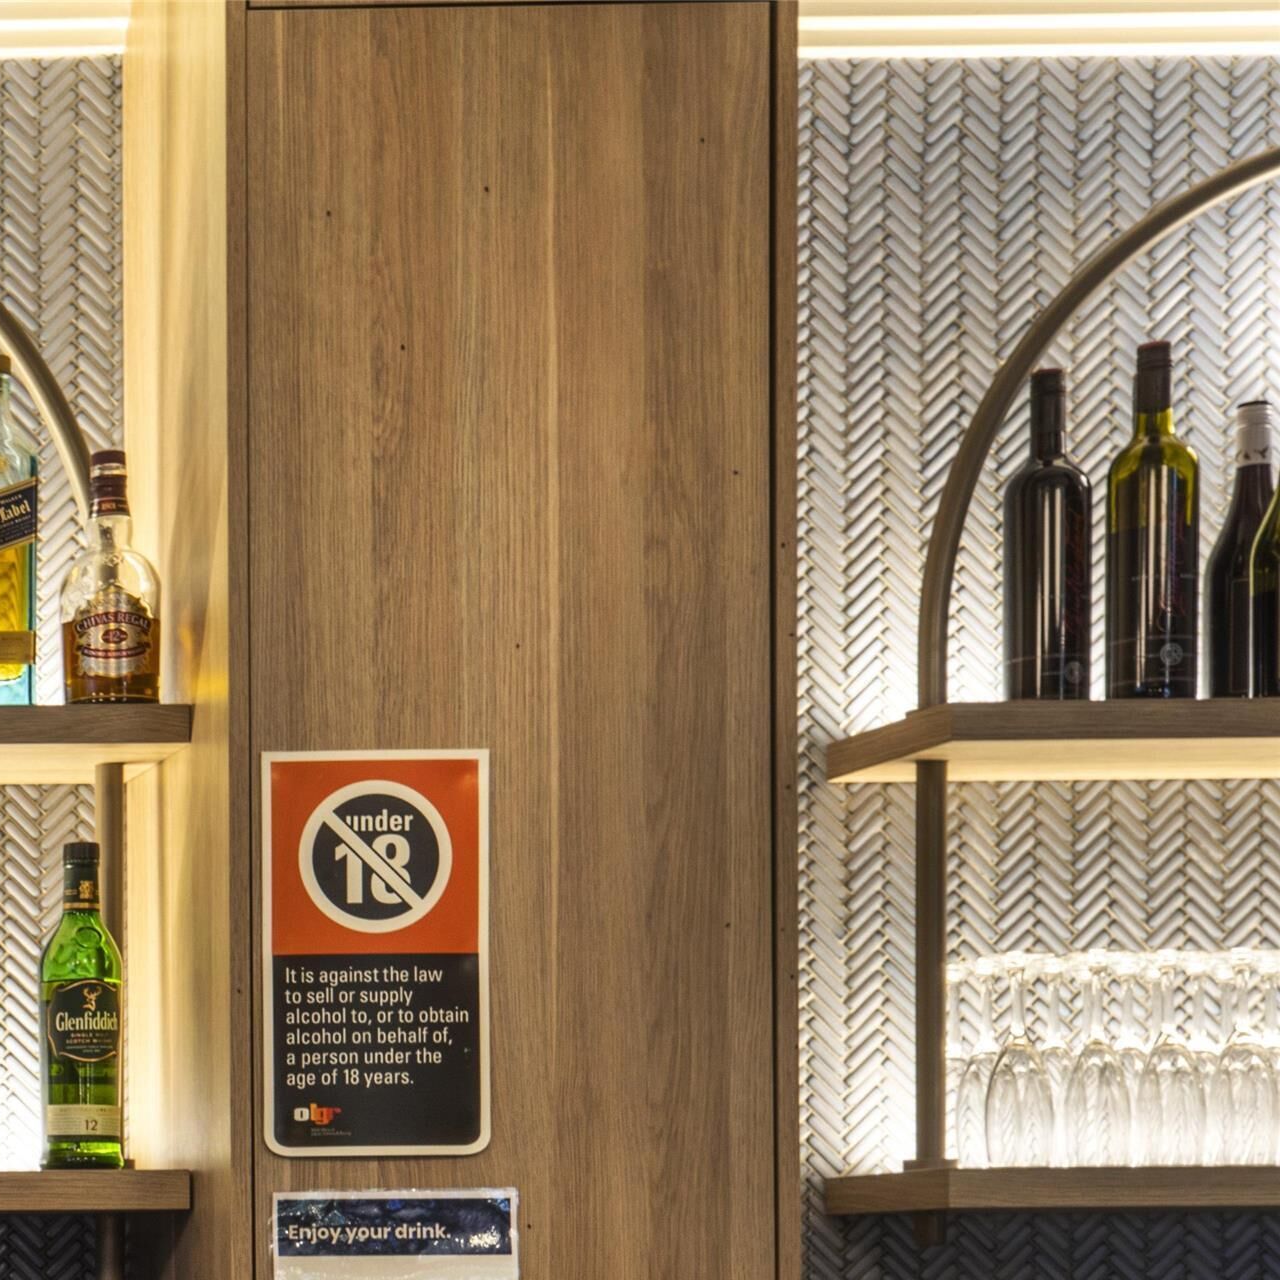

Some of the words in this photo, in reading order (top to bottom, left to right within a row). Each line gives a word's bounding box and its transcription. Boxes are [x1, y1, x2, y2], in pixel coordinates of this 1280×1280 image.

[75, 612, 116, 631] CHIVAS
[117, 611, 150, 629] REGAL
[346, 809, 414, 832] under
[334, 833, 412, 904] 18
[285, 967, 297, 983] It
[300, 967, 314, 983] is
[319, 966, 379, 987] against
[383, 966, 409, 982] the
[413, 966, 443, 983] law
[285, 989, 301, 1004] to
[306, 987, 334, 1003] sell
[339, 990, 355, 1003] or
[359, 987, 413, 1006] supply
[55, 1012, 118, 1033] Glenfiddich
[286, 1008, 346, 1024] alcohol
[351, 1009, 372, 1026] to,
[377, 1010, 393, 1023] or
[398, 1008, 414, 1023] to
[418, 1007, 469, 1023] obtain
[286, 1028, 346, 1045] alcohol
[352, 1031, 372, 1044] on
[377, 1027, 428, 1044] behalf
[432, 1027, 453, 1045] of,
[286, 1053, 295, 1065] a
[301, 1051, 358, 1068] person
[364, 1048, 411, 1064] under
[416, 1048, 442, 1064] the
[286, 1072, 316, 1090] age
[321, 1069, 338, 1085] of
[343, 1069, 359, 1085] 18
[364, 1071, 414, 1088] years.
[289, 1224, 341, 1245] Enjoy
[344, 1226, 391, 1245] your
[395, 1223, 452, 1239] drink.
